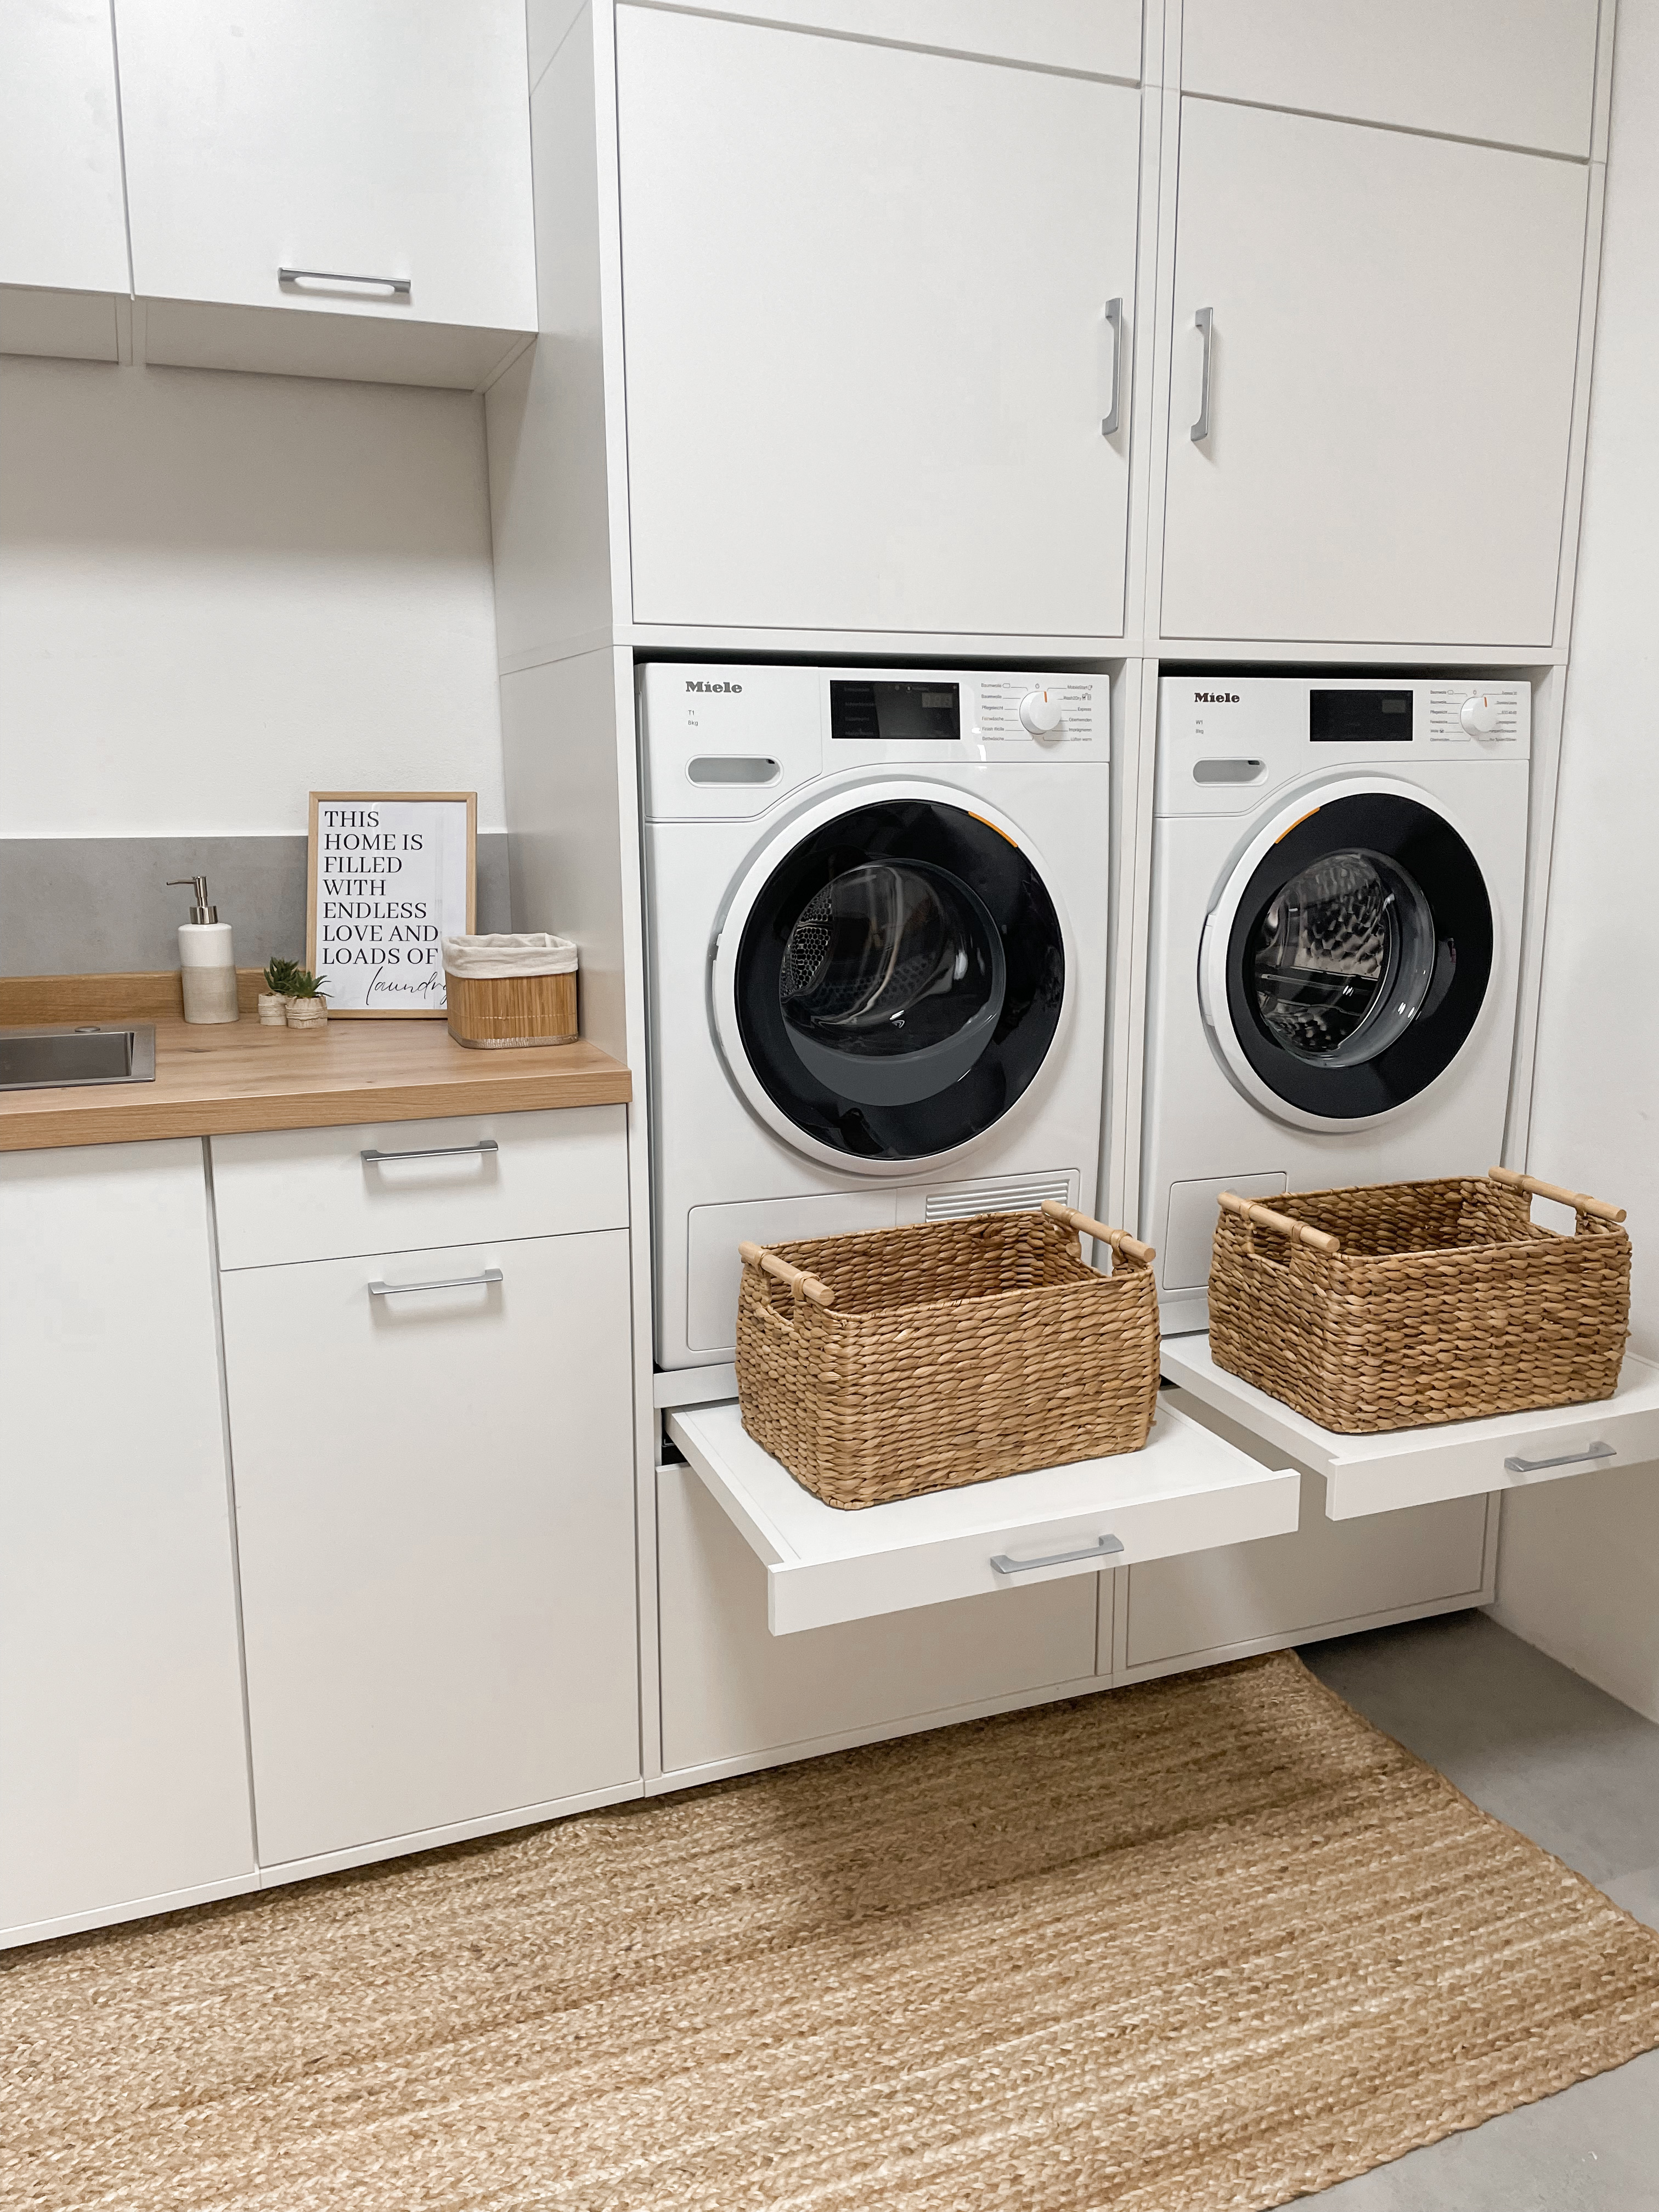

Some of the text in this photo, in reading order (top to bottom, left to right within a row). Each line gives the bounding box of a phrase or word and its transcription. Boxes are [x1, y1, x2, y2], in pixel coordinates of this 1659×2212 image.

[686, 681, 742, 693] Miele
[1194, 692, 1240, 703] Miele
[324, 810, 380, 828] THIS
[324, 833, 423, 851] HOME IS
[324, 856, 402, 873] FILLED
[323, 879, 386, 896] WITH
[323, 902, 427, 919] ENDLESS
[322, 925, 439, 942] LOVE AND
[322, 948, 439, 965] LOADS OF
